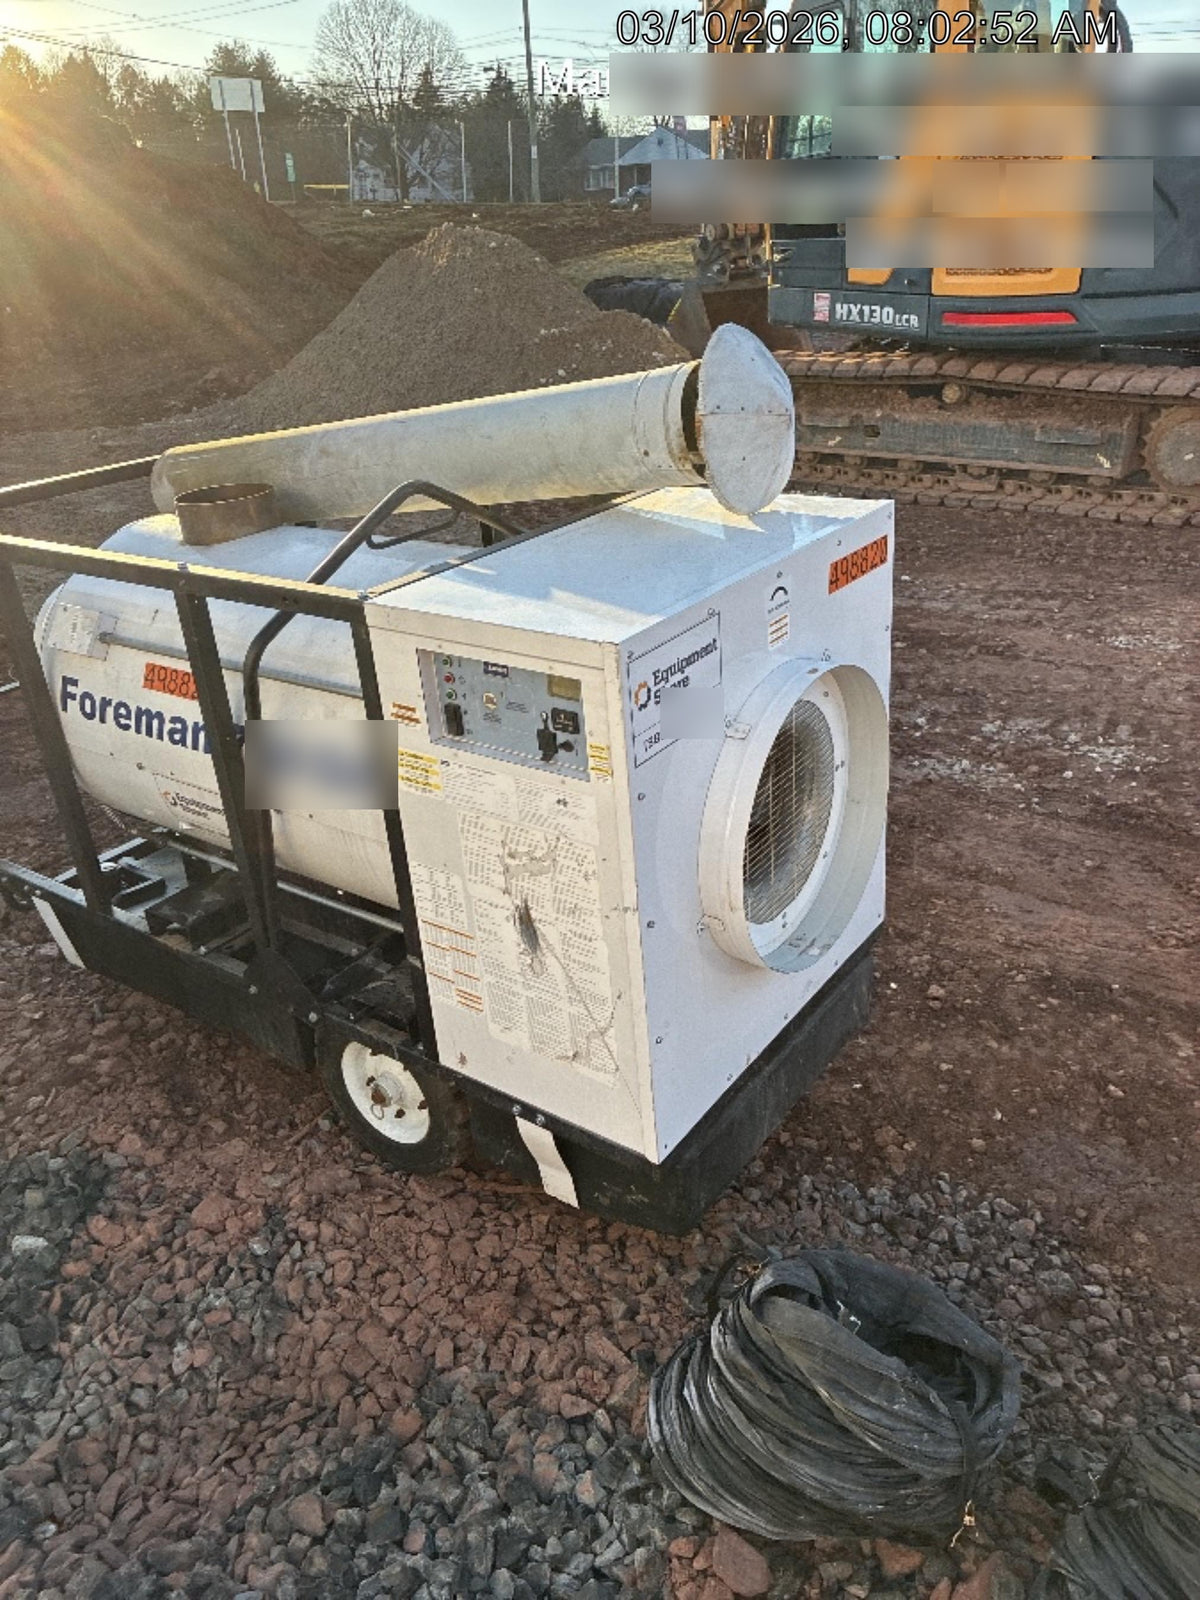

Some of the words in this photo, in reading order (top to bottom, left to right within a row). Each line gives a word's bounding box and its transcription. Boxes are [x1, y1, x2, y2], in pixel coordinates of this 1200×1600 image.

[144, 663, 199, 698] 4988
[652, 638, 717, 687] Equipment
[61, 675, 214, 755] Foreman
